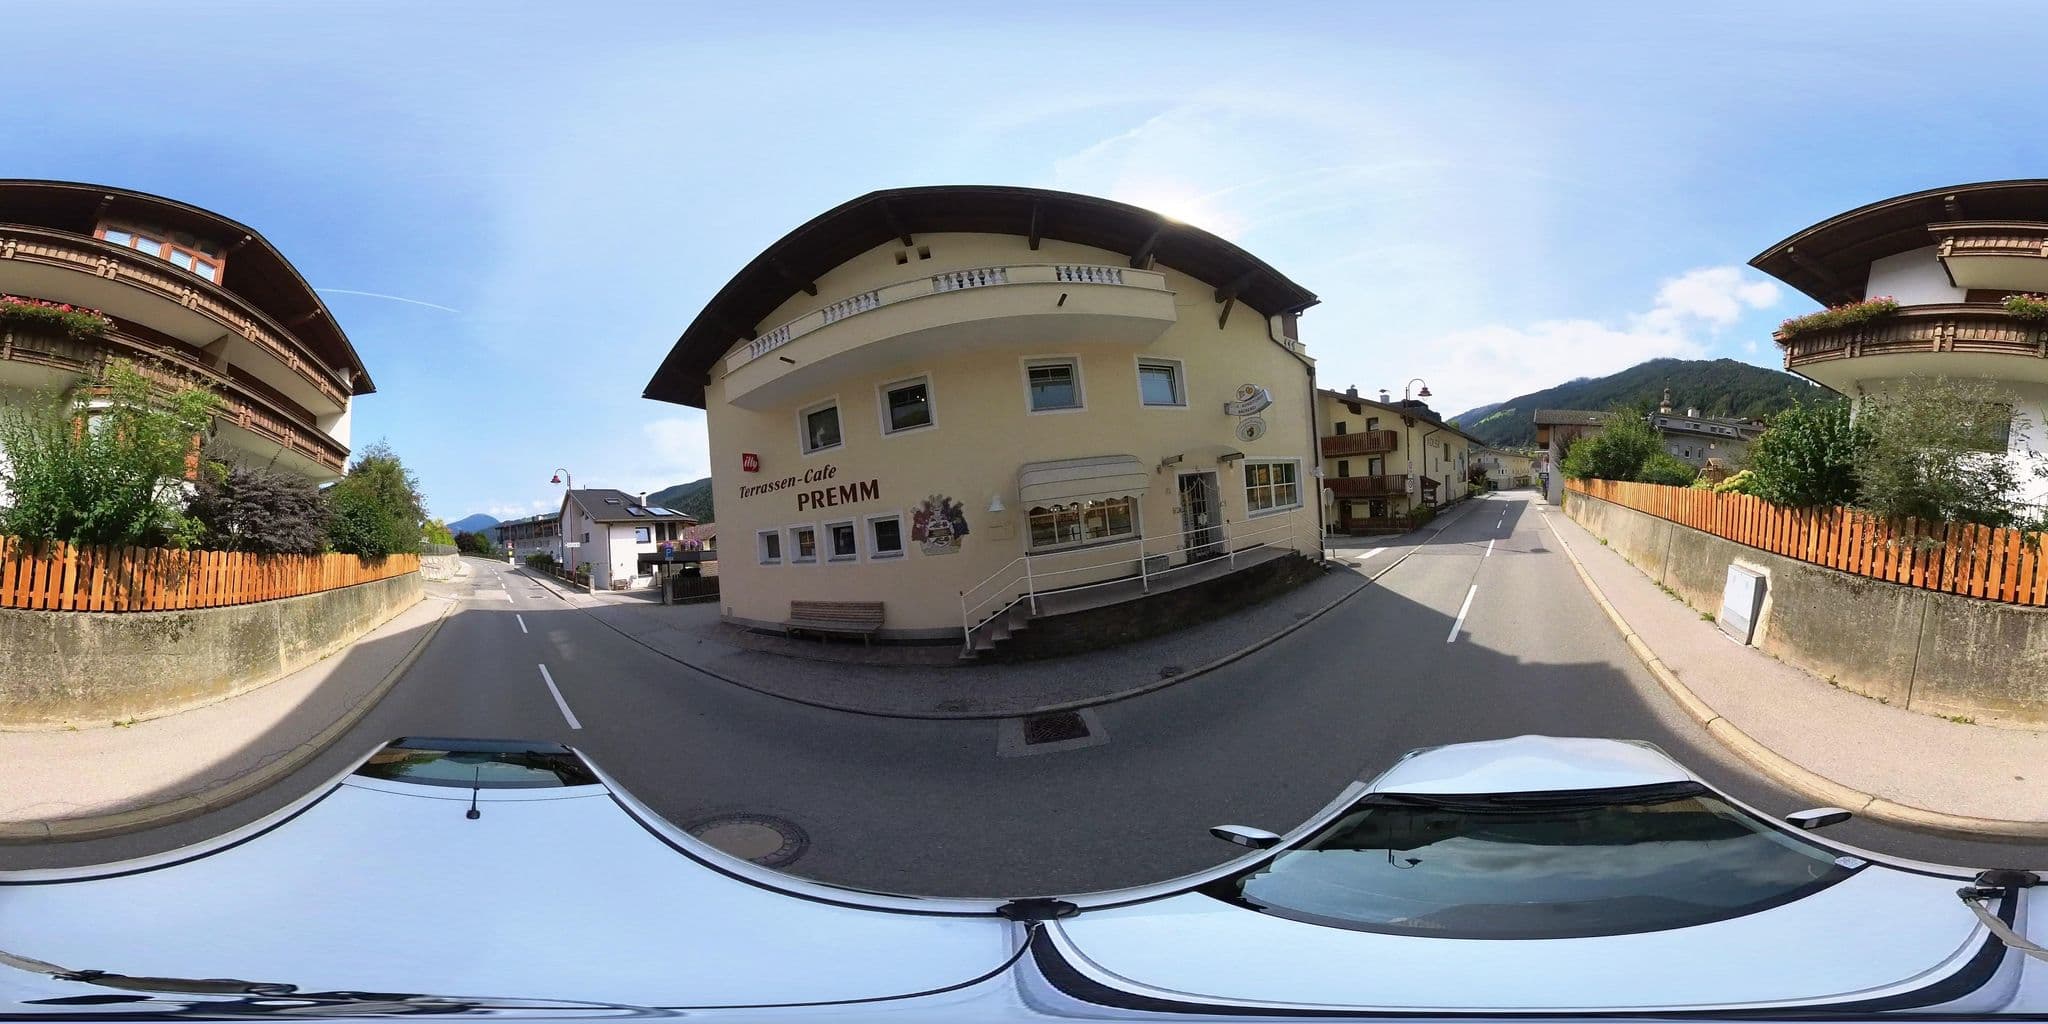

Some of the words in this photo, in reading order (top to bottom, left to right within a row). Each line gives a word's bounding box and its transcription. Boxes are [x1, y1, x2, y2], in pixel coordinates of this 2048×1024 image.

[744, 456, 758, 470] illy
[739, 464, 837, 499] Terrassen-Cafe
[796, 479, 880, 511] PREMM
